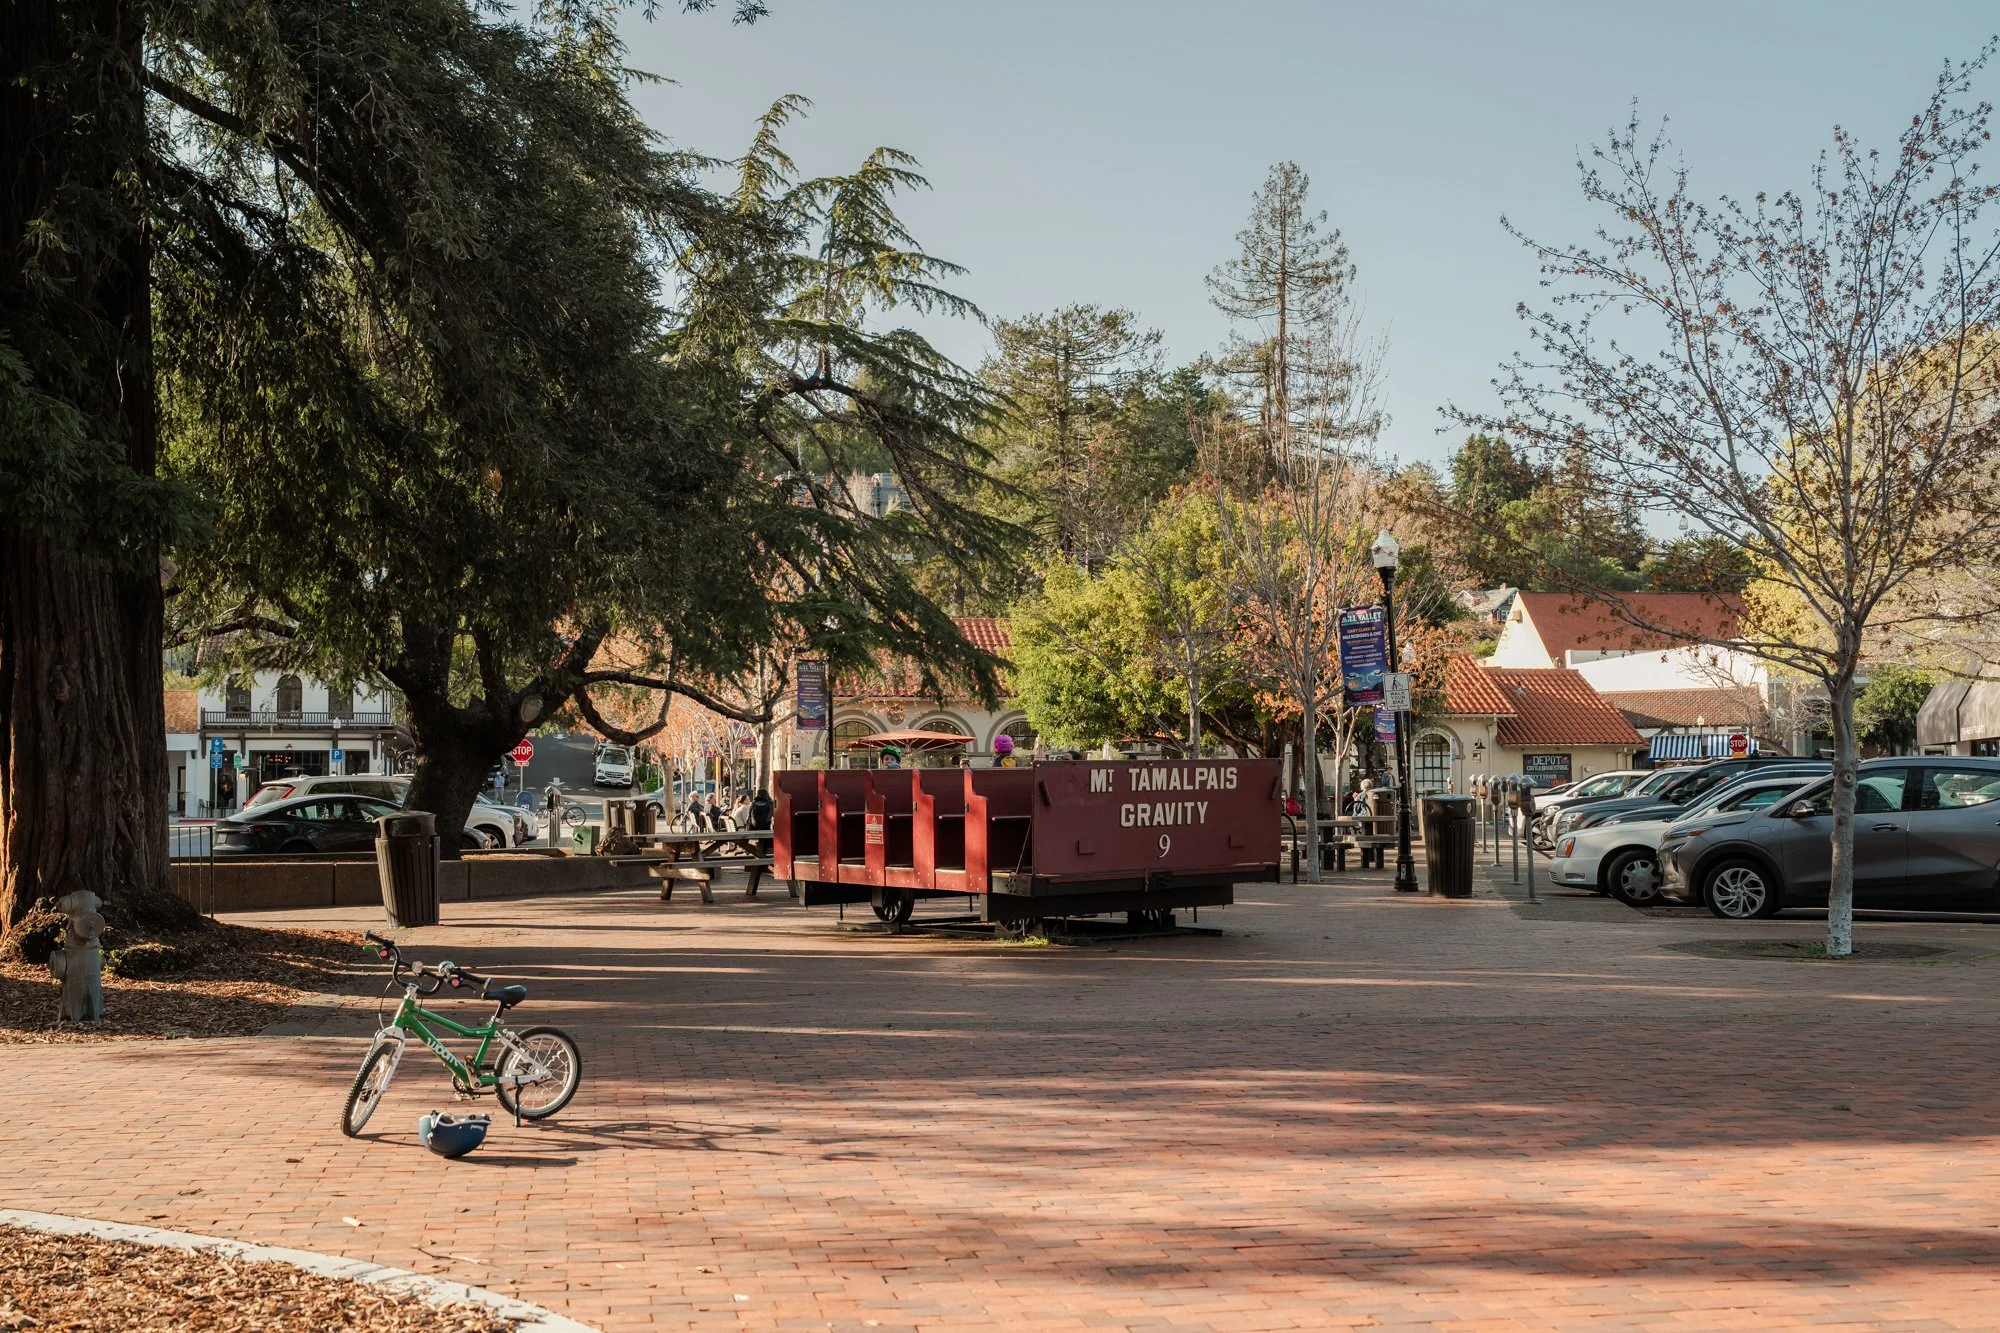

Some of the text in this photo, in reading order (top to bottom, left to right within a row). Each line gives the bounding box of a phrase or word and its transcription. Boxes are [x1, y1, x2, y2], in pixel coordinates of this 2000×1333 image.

[1357, 611, 1382, 621] VALLEY
[1730, 739, 1747, 748] STOP
[334, 750, 340, 759] P
[512, 746, 532, 755] STOP
[1532, 755, 1562, 766] DEPOT
[1128, 766, 1238, 792] TAMALPAIS
[1120, 801, 1209, 827] GRAVITY
[1158, 833, 1171, 858] 9
